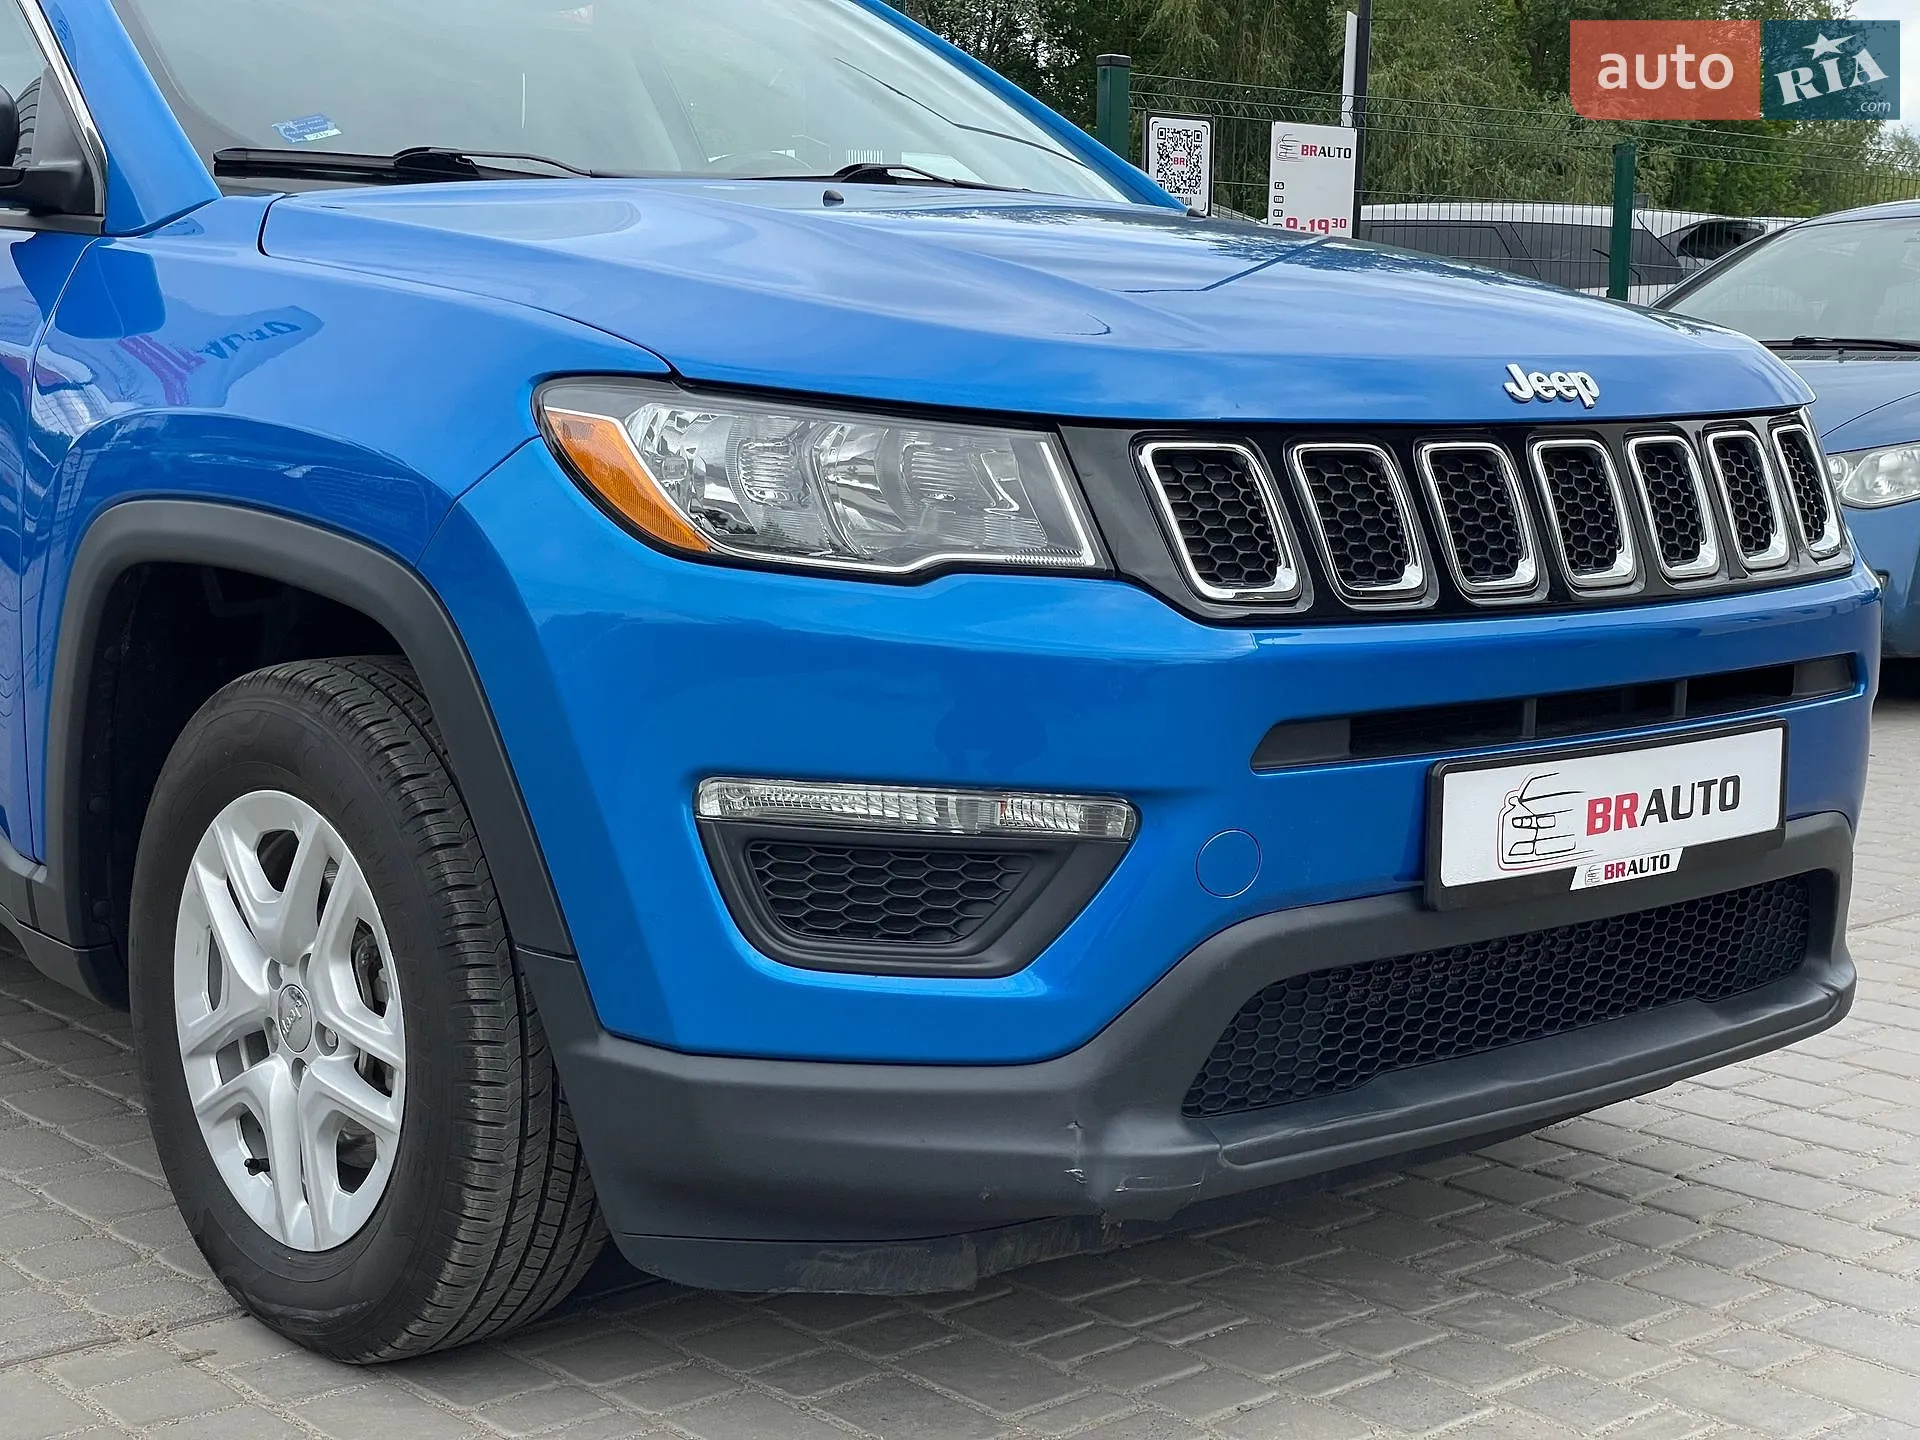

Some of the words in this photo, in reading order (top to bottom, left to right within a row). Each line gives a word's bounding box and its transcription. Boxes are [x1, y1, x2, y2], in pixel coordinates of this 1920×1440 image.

[1173, 157, 1185, 165] BR
[1301, 144, 1352, 159] BRAUTO
[1503, 363, 1600, 409] Jeep
[1586, 774, 1741, 836] BRAUTO
[1603, 854, 1670, 881] BRAUTO
